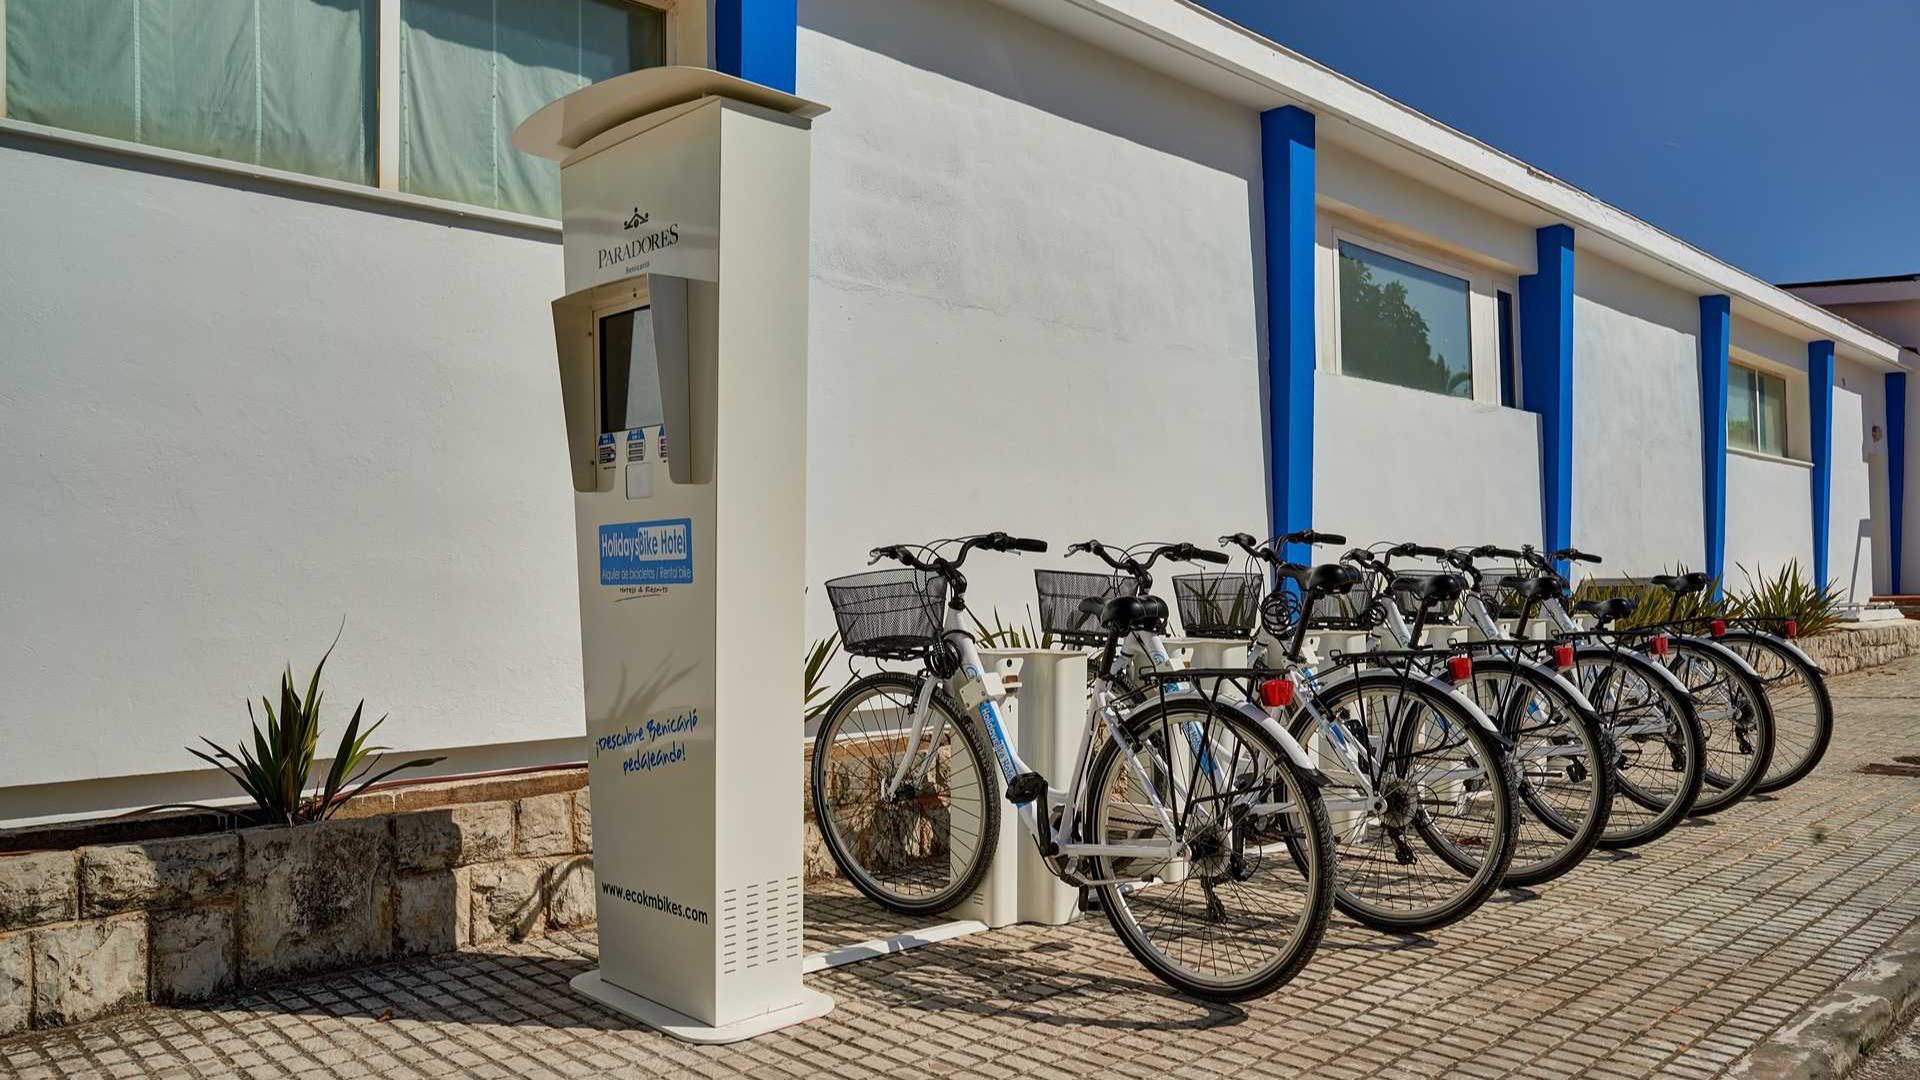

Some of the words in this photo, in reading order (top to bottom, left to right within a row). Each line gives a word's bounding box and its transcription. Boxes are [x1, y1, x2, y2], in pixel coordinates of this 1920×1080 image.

[598, 223, 679, 269] PARADORES
[660, 526, 686, 555] Hotel
[679, 565, 692, 579] bike
[596, 724, 645, 758] ¡Descubre
[647, 708, 698, 742] Benicarló
[623, 740, 686, 776] pedaleando!
[601, 881, 708, 925] www.ecokmbikes.com
